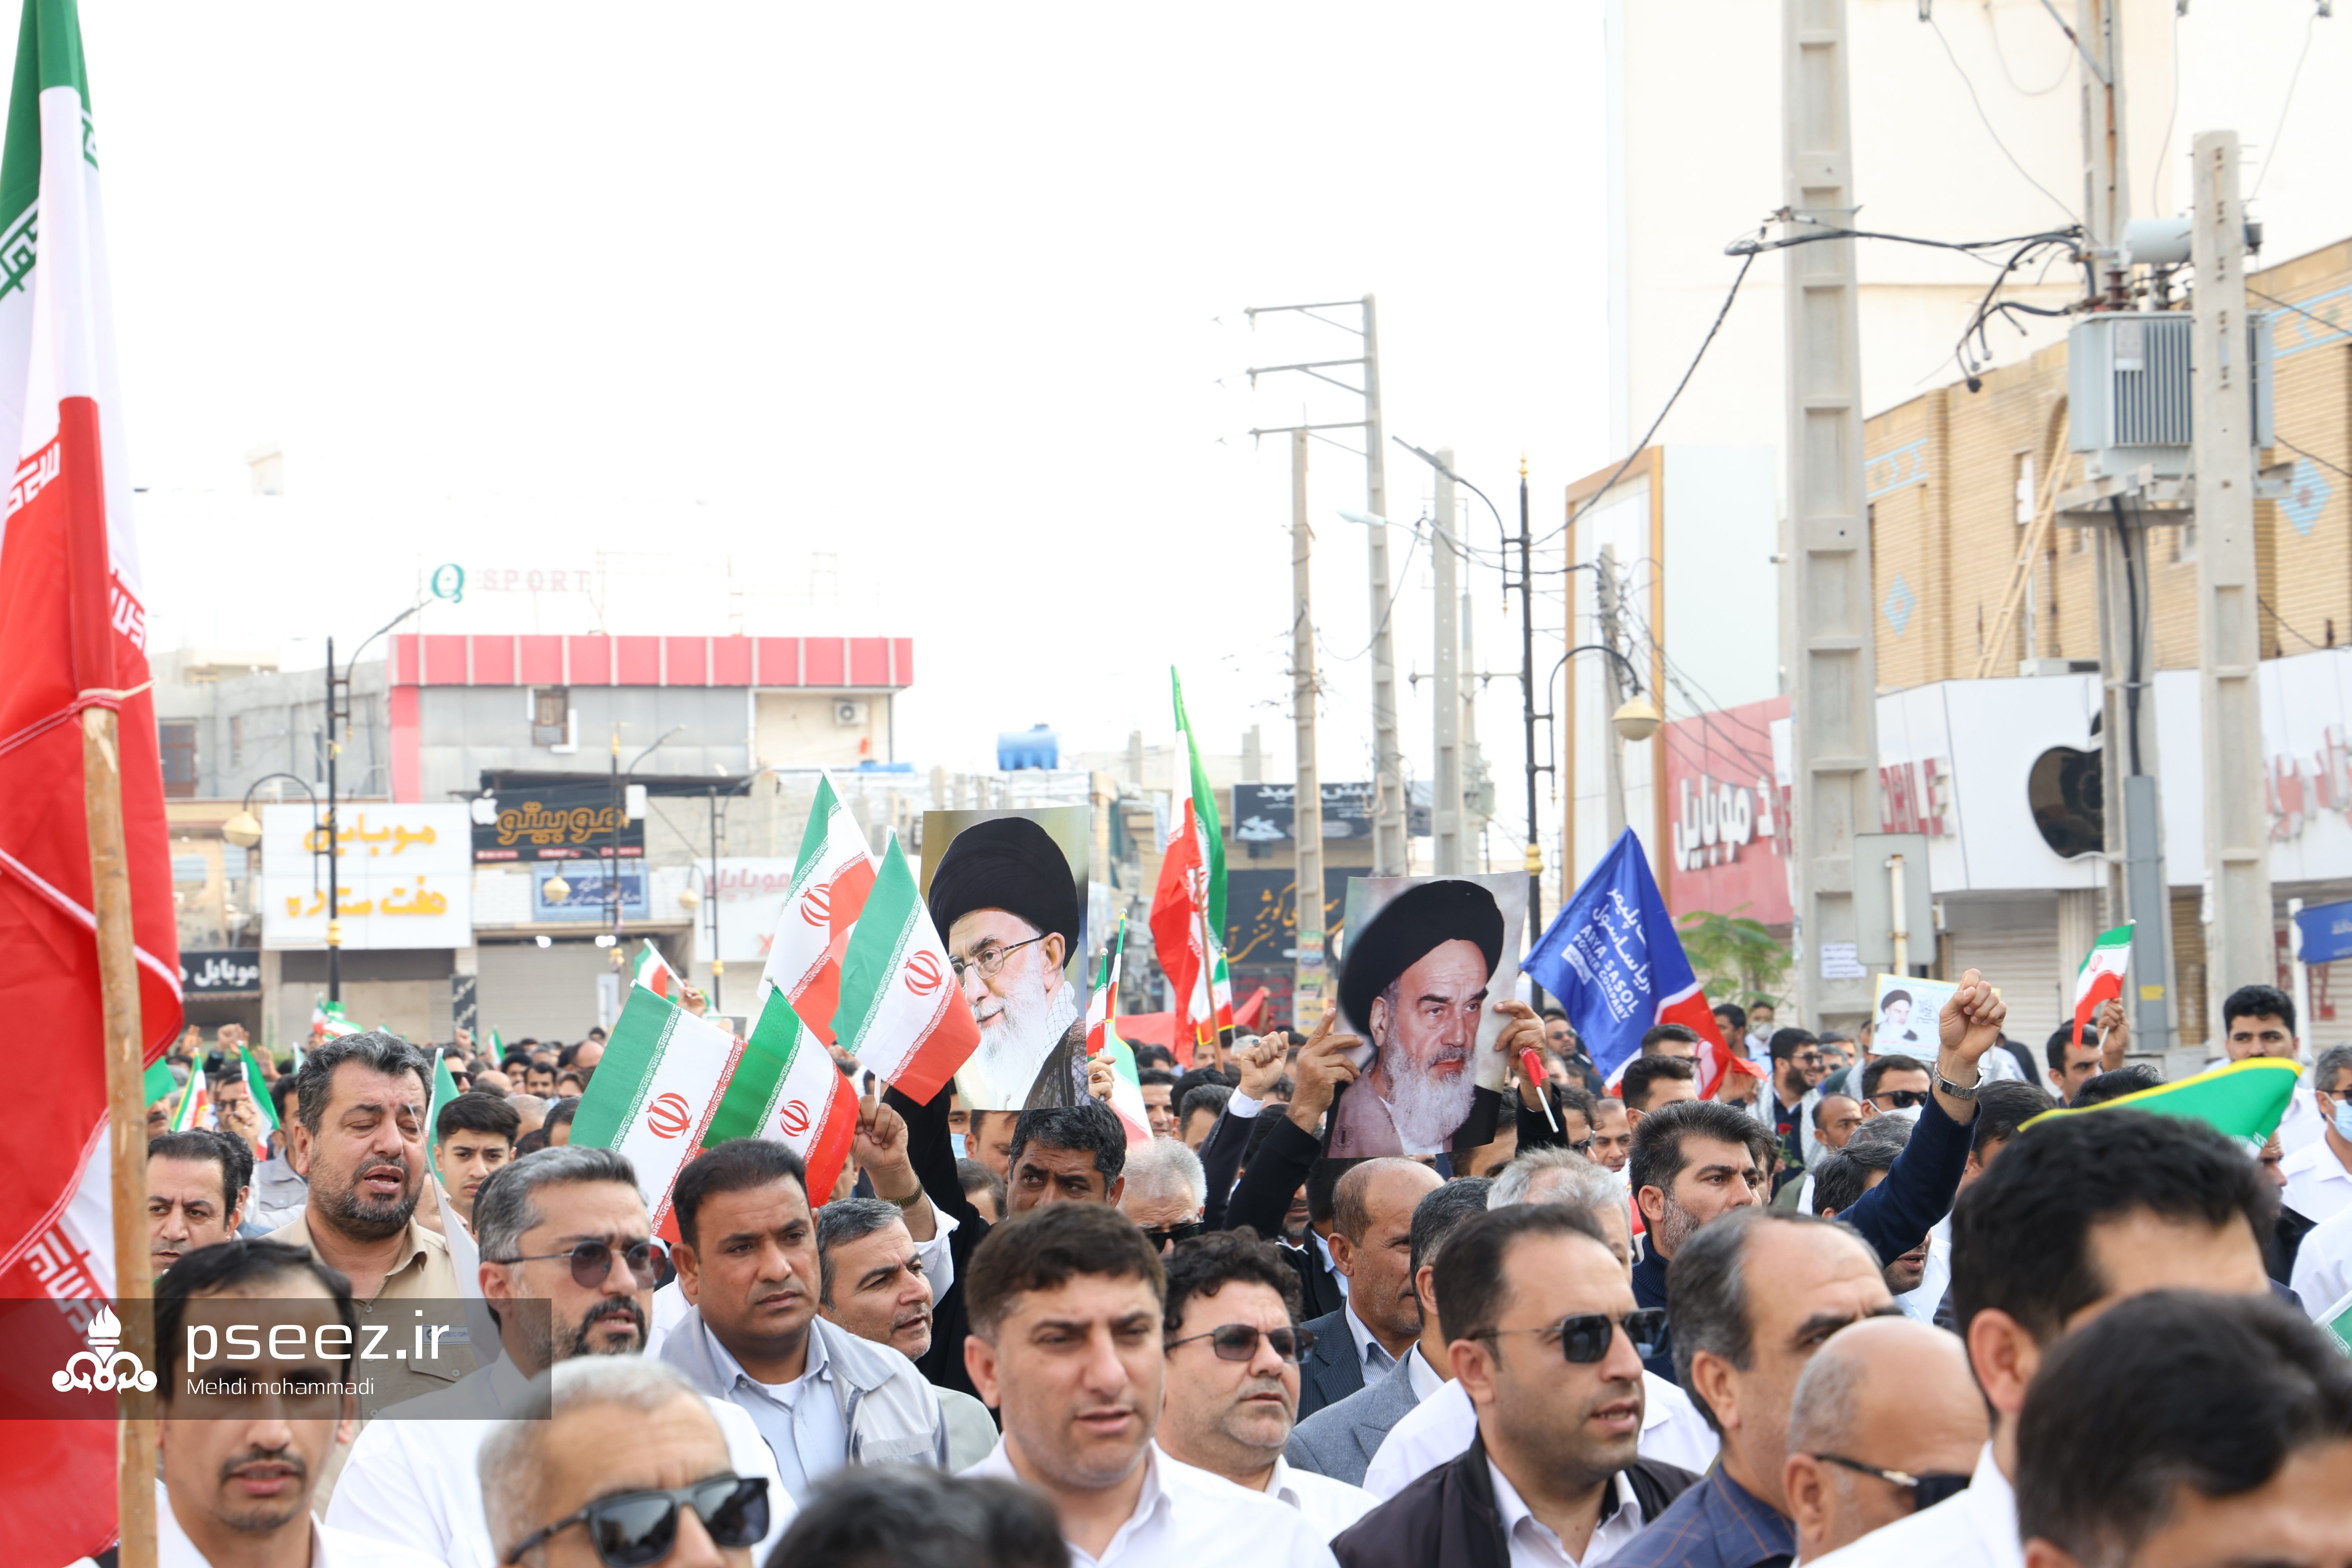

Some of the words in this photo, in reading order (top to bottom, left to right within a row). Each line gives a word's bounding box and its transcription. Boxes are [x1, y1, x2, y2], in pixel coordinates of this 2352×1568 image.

[432, 563, 465, 604] Q
[483, 568, 590, 592] SPORT
[304, 812, 436, 856] موبایل
[1673, 774, 1755, 871] موبایل
[287, 887, 373, 918] ستره
[379, 875, 448, 915] هفت
[706, 868, 791, 901] موبایل
[1606, 888, 1640, 930] پلیمر
[193, 957, 260, 988] موبایل
[1604, 959, 1640, 1014] SASOL
[1598, 969, 1631, 1019] COMPANY
